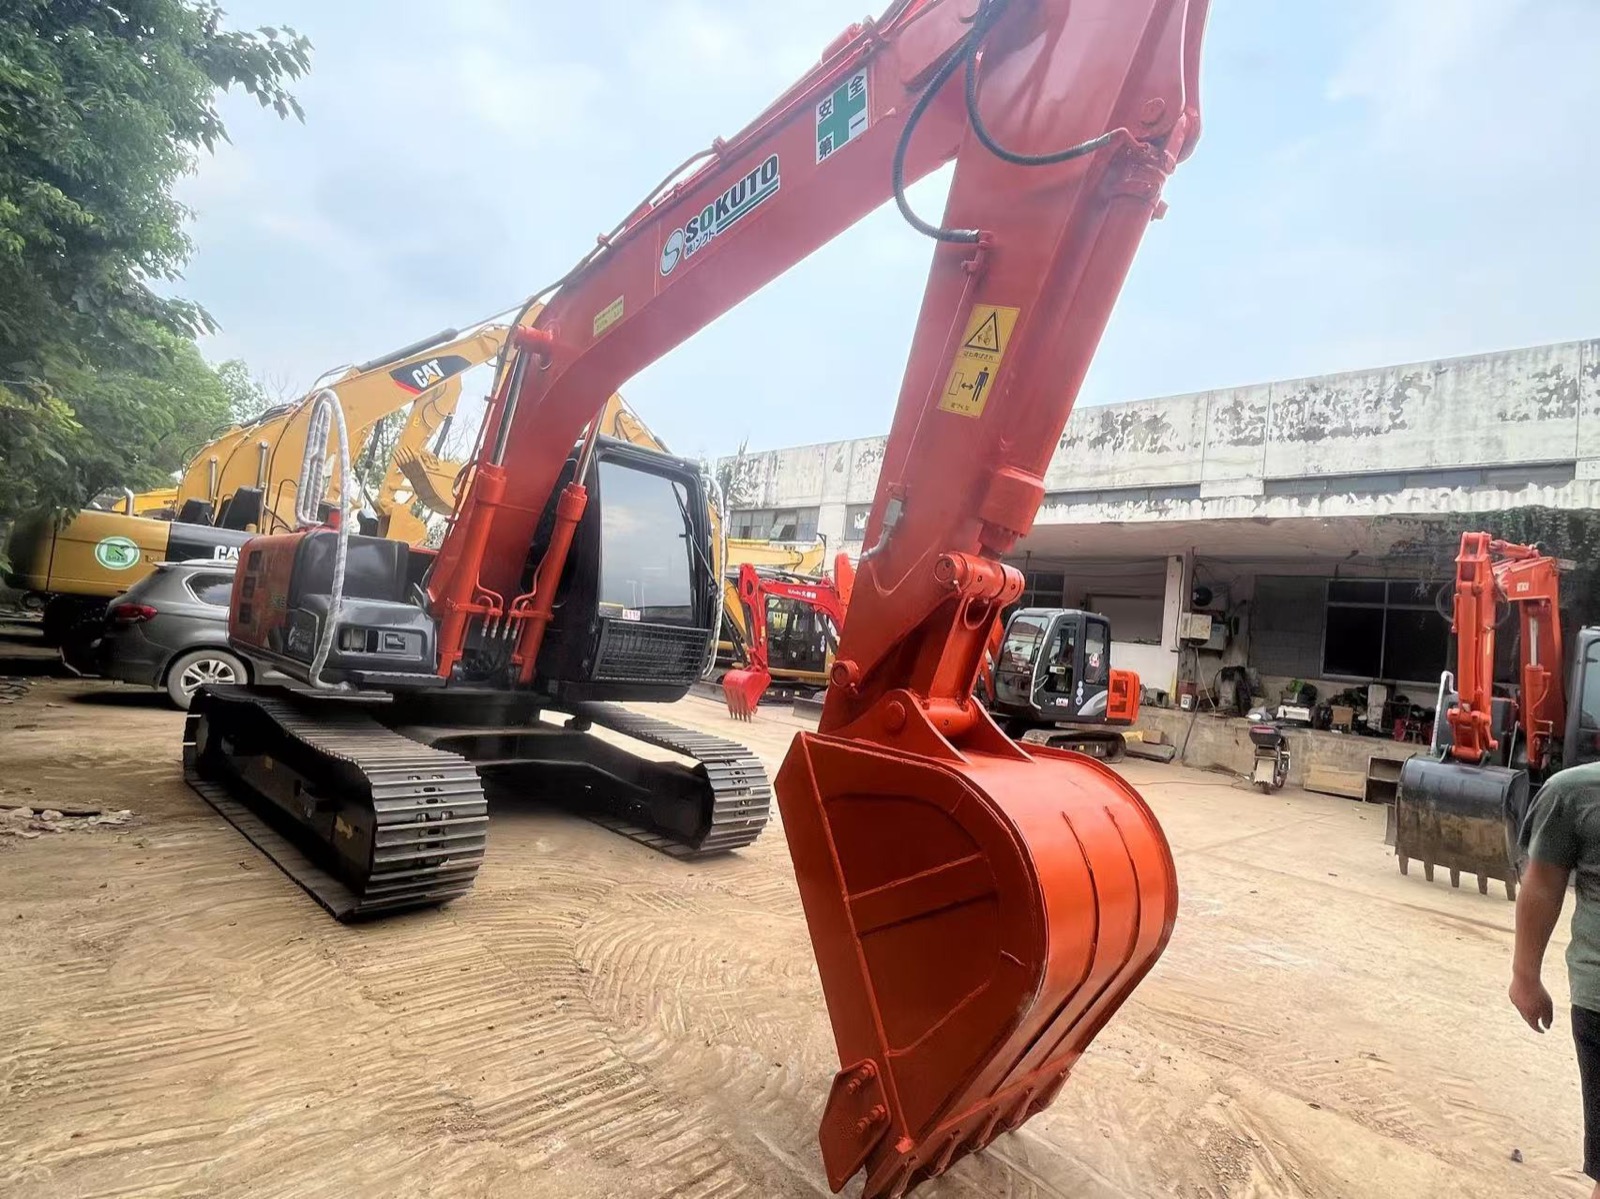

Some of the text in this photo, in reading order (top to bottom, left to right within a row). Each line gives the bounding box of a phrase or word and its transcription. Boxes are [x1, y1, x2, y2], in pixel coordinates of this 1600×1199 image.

[685, 156, 778, 243] SOKUTO
[412, 359, 445, 388] CAT
[213, 545, 242, 562] CA
